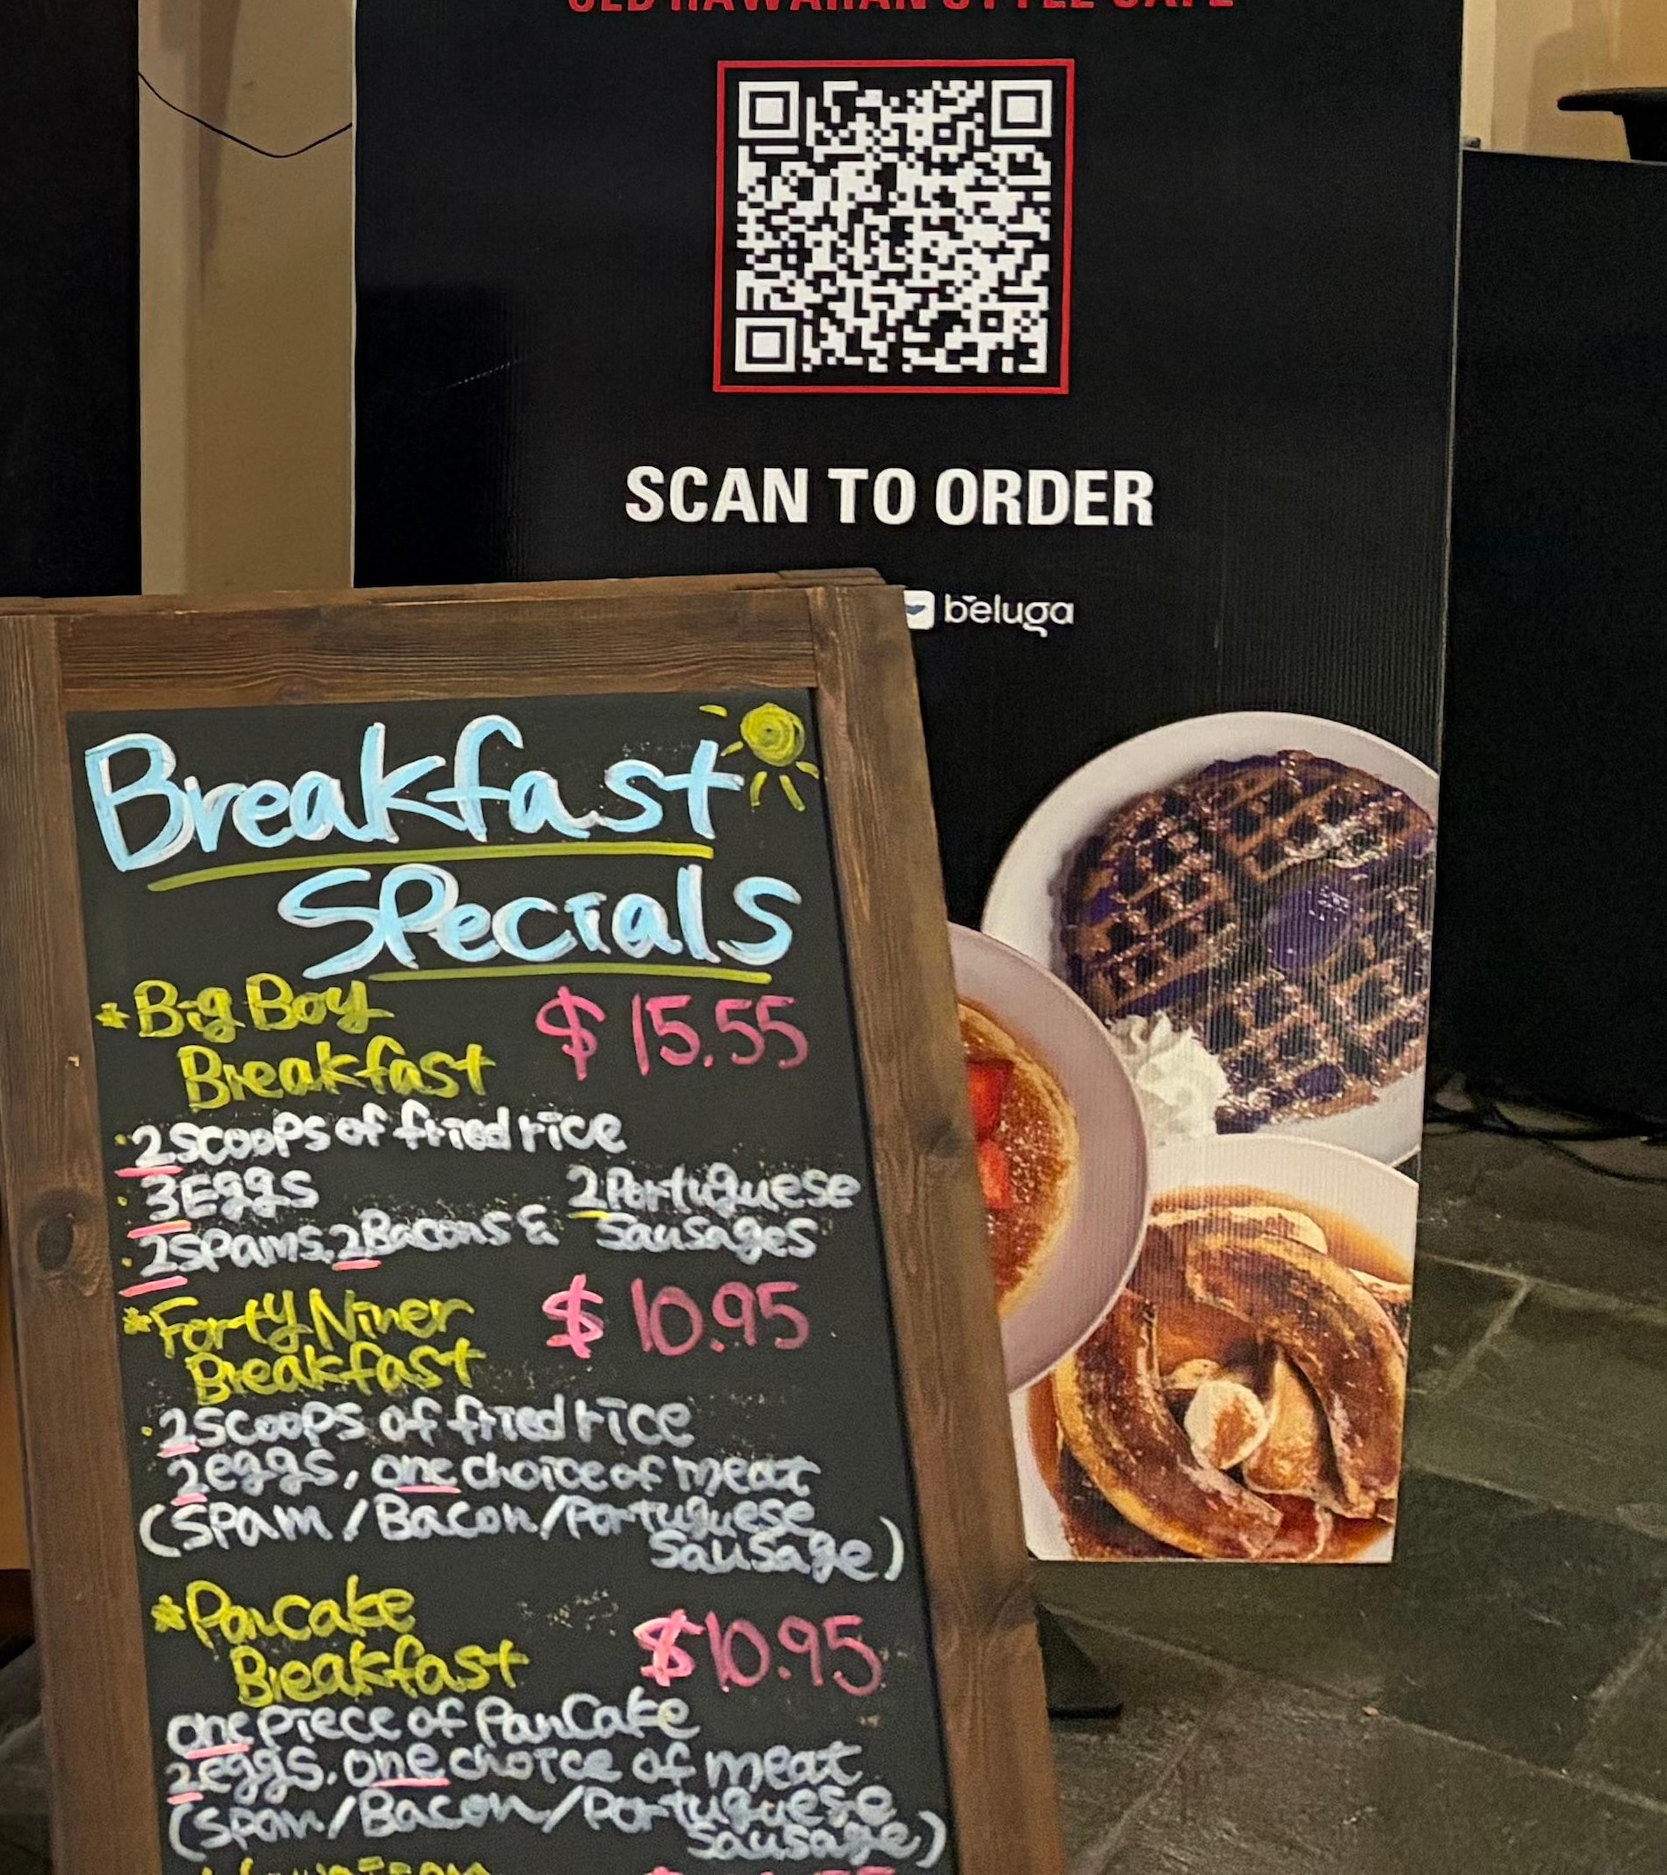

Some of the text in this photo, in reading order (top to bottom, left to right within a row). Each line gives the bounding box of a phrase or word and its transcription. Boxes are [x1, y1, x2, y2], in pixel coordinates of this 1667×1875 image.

[624, 465, 1154, 527] SCAN TO ORDER
[944, 590, 1075, 637] beluga
[85, 714, 745, 872] Breakfast
[134, 980, 240, 1042] Big
[249, 974, 394, 1035] Boy
[178, 1037, 496, 1110] Breakfast
[335, 1100, 390, 1151] of
[518, 1106, 628, 1154] rice
[149, 1288, 313, 1359] Forty
[308, 1288, 474, 1352] Niner
[185, 1337, 486, 1405] Breakfast
[186, 1575, 883, 1697] Pancake $10.95
[231, 1635, 529, 1708] Breakfast
